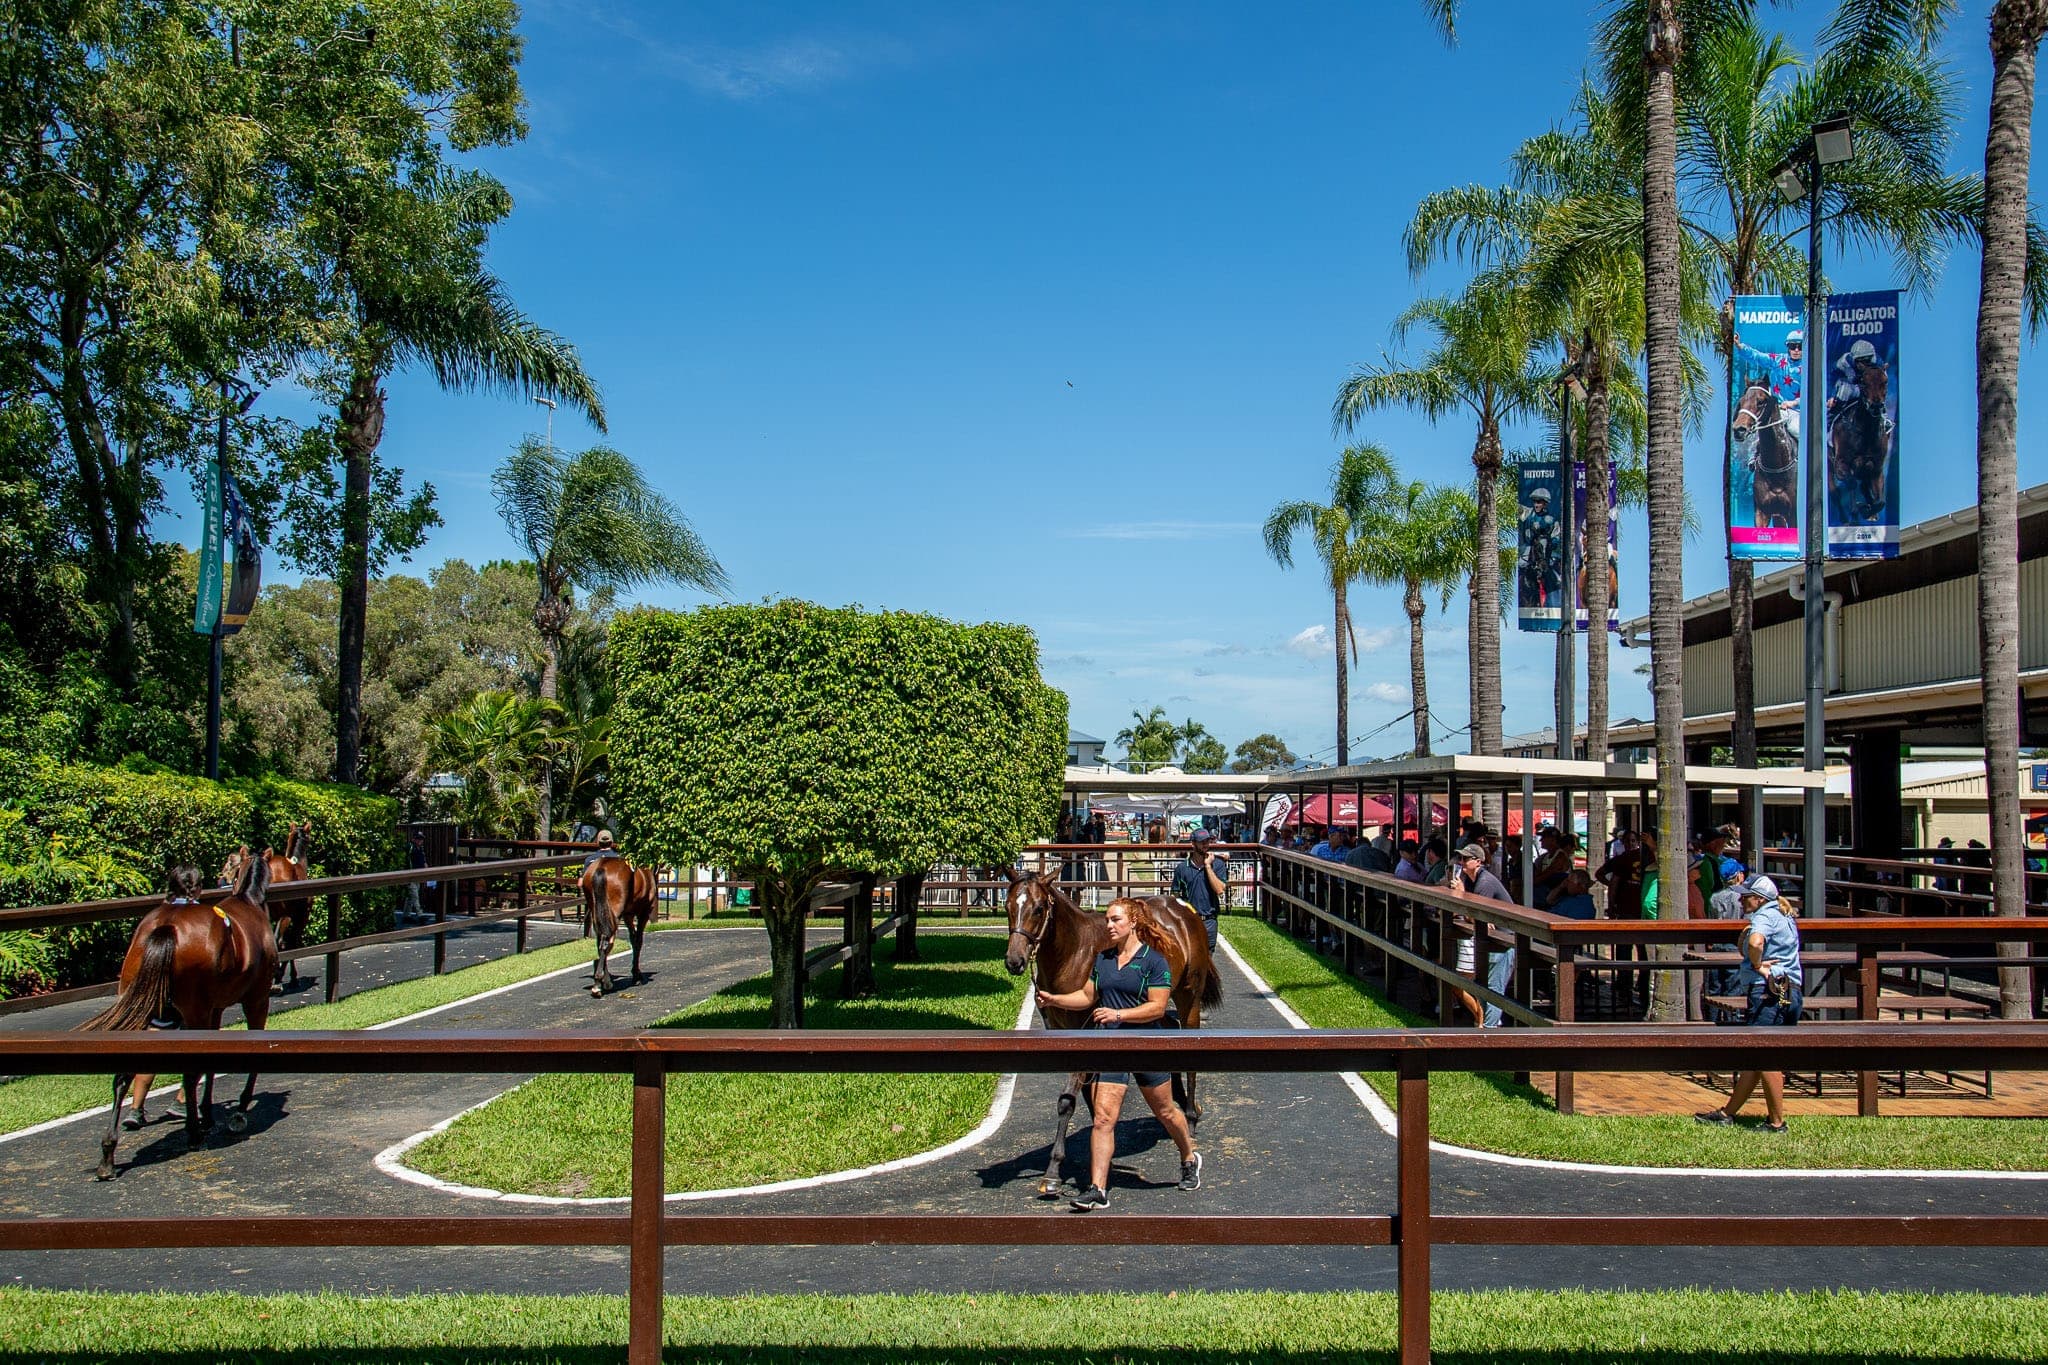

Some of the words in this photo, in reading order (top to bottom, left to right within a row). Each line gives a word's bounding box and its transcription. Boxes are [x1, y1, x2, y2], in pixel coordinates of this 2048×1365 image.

[1739, 311, 1800, 324] MANZOICE
[1829, 307, 1896, 323] ALLIGATOR
[1842, 322, 1883, 336] BLOOD
[1524, 470, 1555, 479] HITOTSU
[209, 506, 217, 551] LIVE!
